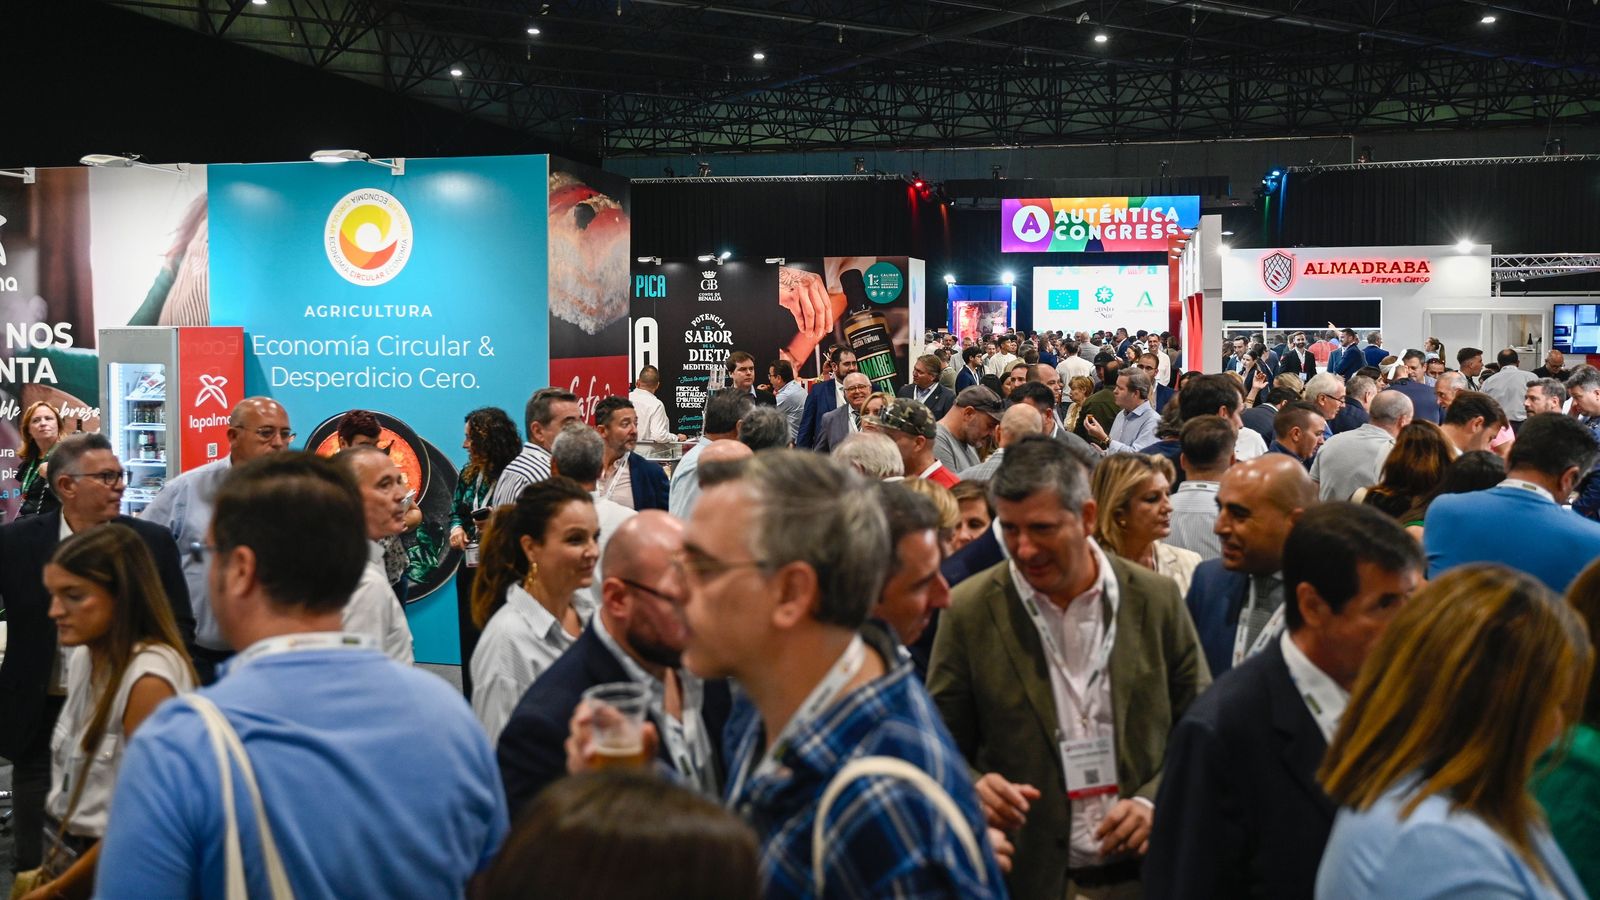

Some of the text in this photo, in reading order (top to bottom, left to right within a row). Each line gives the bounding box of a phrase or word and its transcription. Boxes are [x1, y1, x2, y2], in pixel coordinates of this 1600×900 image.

[1055, 203, 1179, 224] AUTÉNTICA
[1055, 223, 1179, 240] CONGRESS
[1304, 261, 1430, 275] ALMADRABA
[636, 275, 666, 297] PICA
[304, 305, 432, 318] AGRICULTURA
[691, 314, 726, 329] POTENCIA
[6, 322, 74, 349] NOS
[684, 330, 734, 345] SABOR
[252, 335, 495, 356] Economía Circular &
[688, 349, 730, 362] DIETA
[272, 366, 480, 392] Desperdicio Cero.
